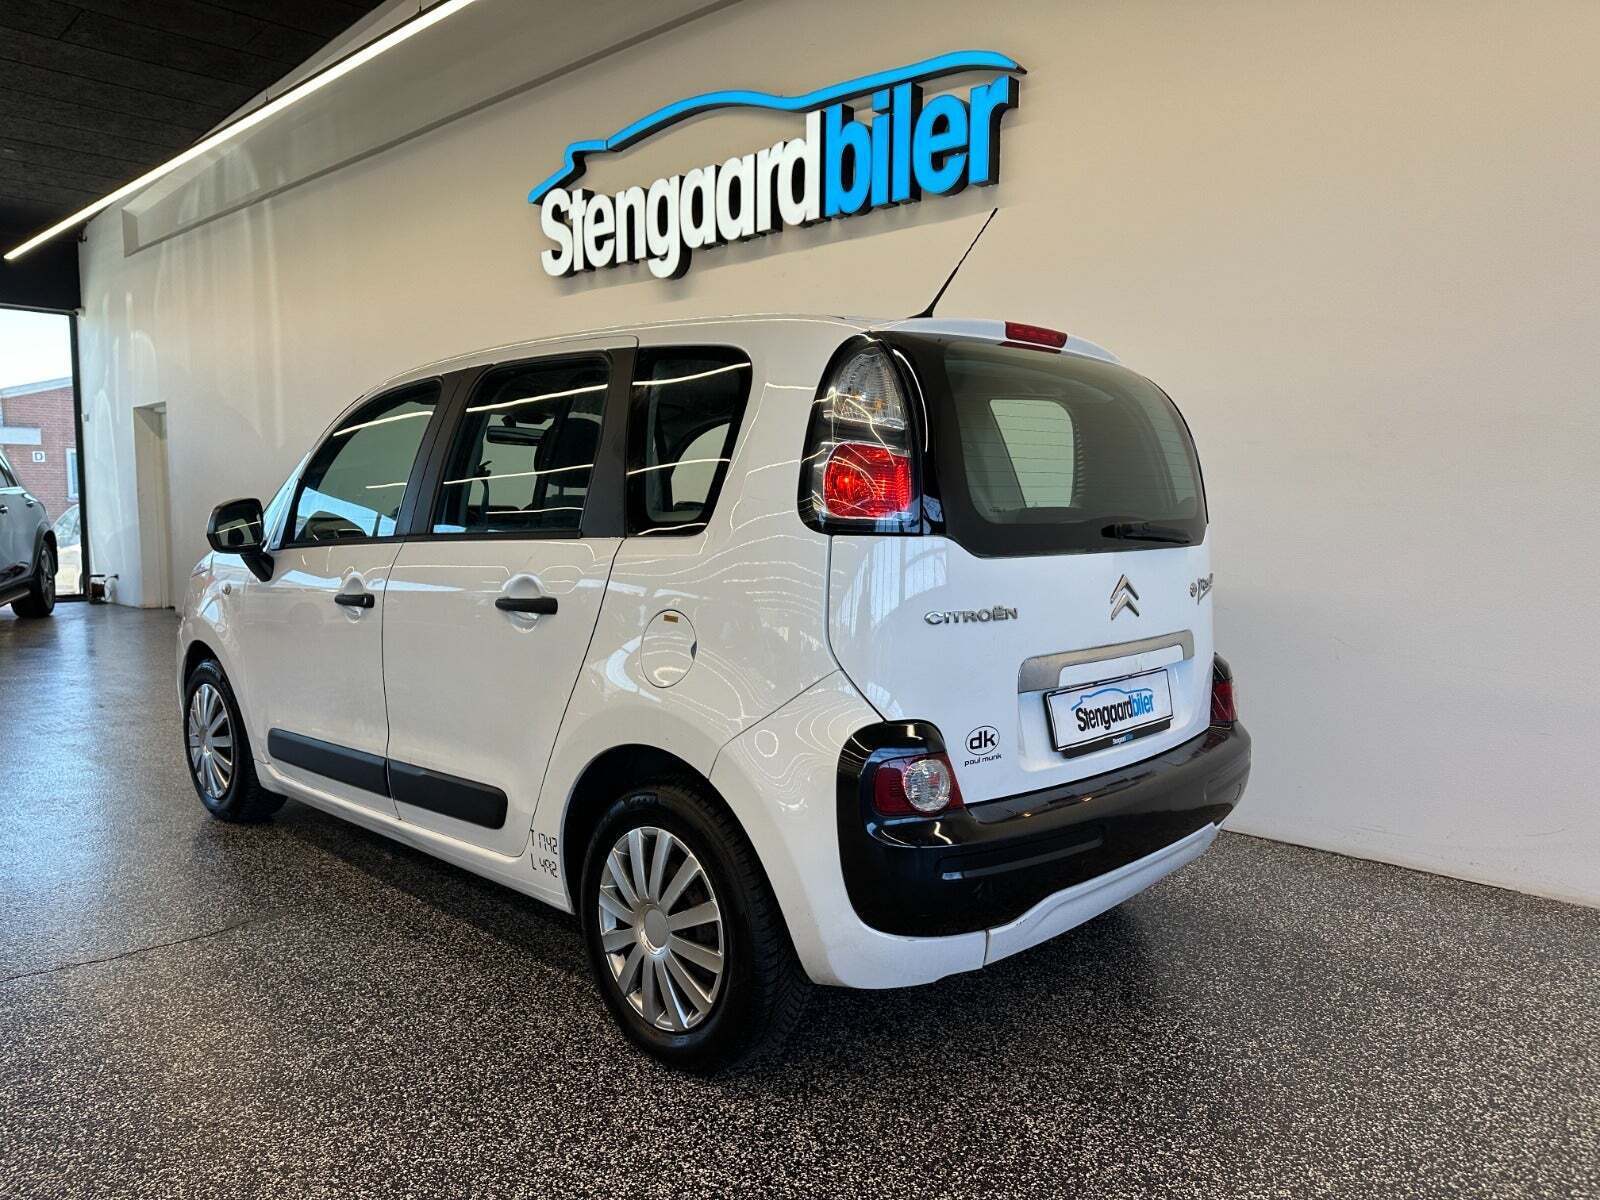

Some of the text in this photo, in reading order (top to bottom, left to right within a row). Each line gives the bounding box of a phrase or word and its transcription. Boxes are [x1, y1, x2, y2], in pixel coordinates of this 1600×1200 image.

[540, 76, 1015, 279] Stengaardbiler
[923, 604, 1018, 625] CITROËN
[1075, 693, 1154, 732] Stengaardbiler
[969, 729, 996, 750] dk
[981, 752, 1002, 763] munk
